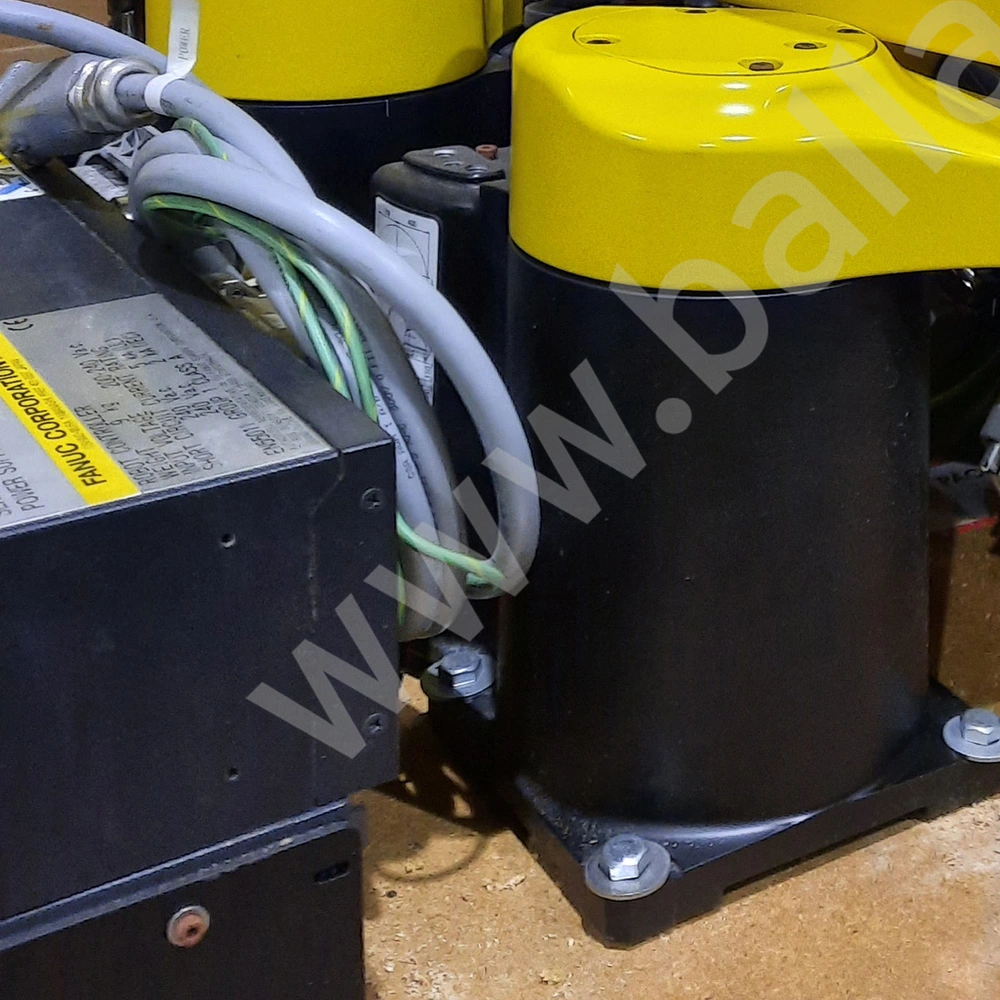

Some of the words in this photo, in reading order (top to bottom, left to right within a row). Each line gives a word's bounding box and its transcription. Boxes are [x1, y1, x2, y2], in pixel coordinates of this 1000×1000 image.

[171, 361, 212, 385] CLASS
[207, 394, 248, 420] GROUP
[72, 404, 132, 455] CONTROLLER
[127, 411, 176, 447] VOLTAGE
[148, 409, 195, 440] CIRCUIT
[53, 441, 107, 486] FANUC
[117, 457, 159, 485] ROBOT
[134, 446, 180, 480] WEIGHT
[181, 443, 224, 470] SHORT
[1, 476, 44, 512] POWER
